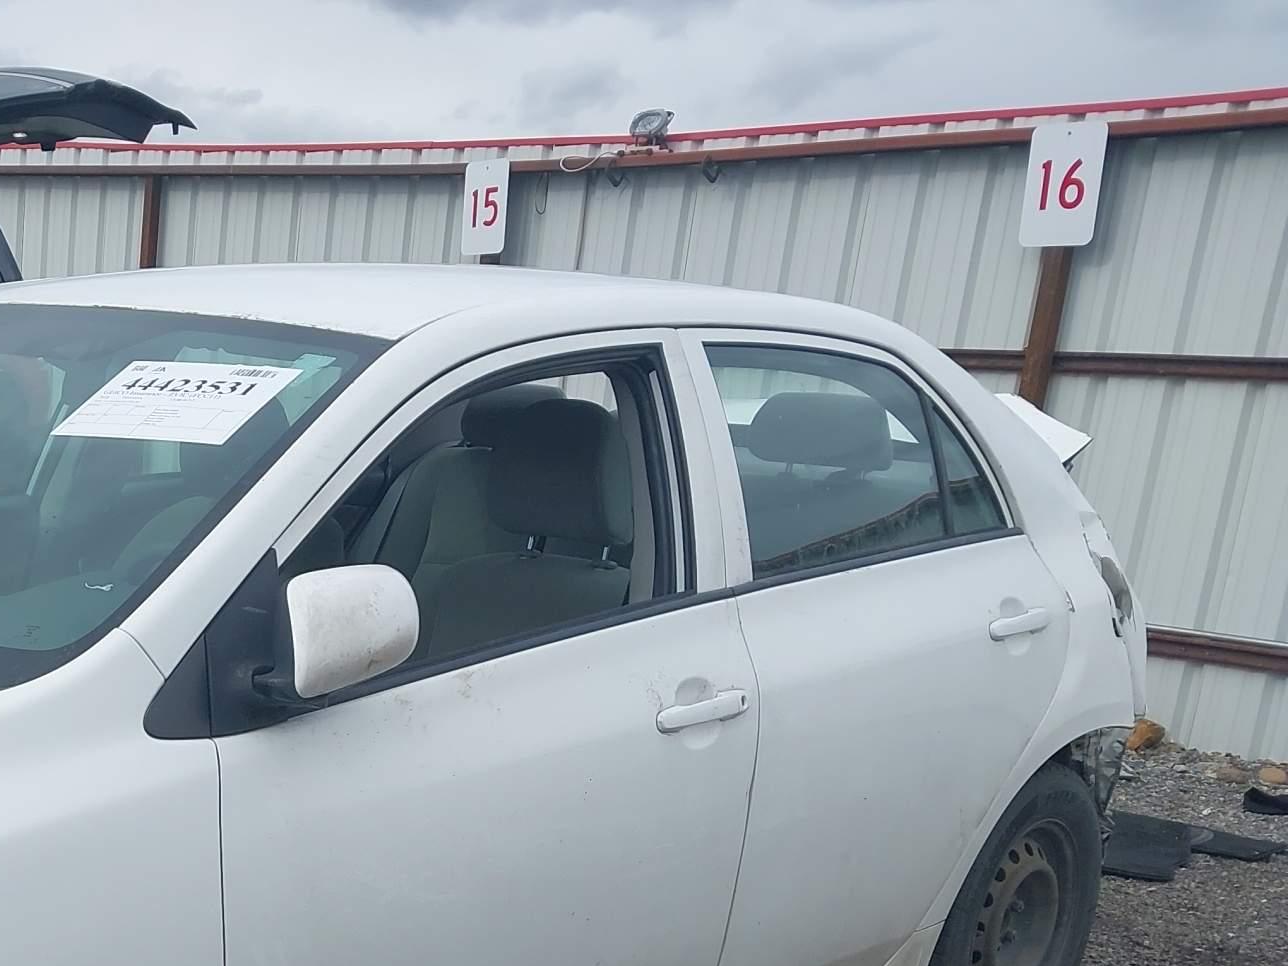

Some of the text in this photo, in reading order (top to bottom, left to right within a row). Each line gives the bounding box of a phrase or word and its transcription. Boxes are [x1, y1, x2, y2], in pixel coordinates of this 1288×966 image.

[1039, 159, 1085, 210] 16
[471, 187, 498, 228] 15
[121, 377, 258, 396] 44423531
